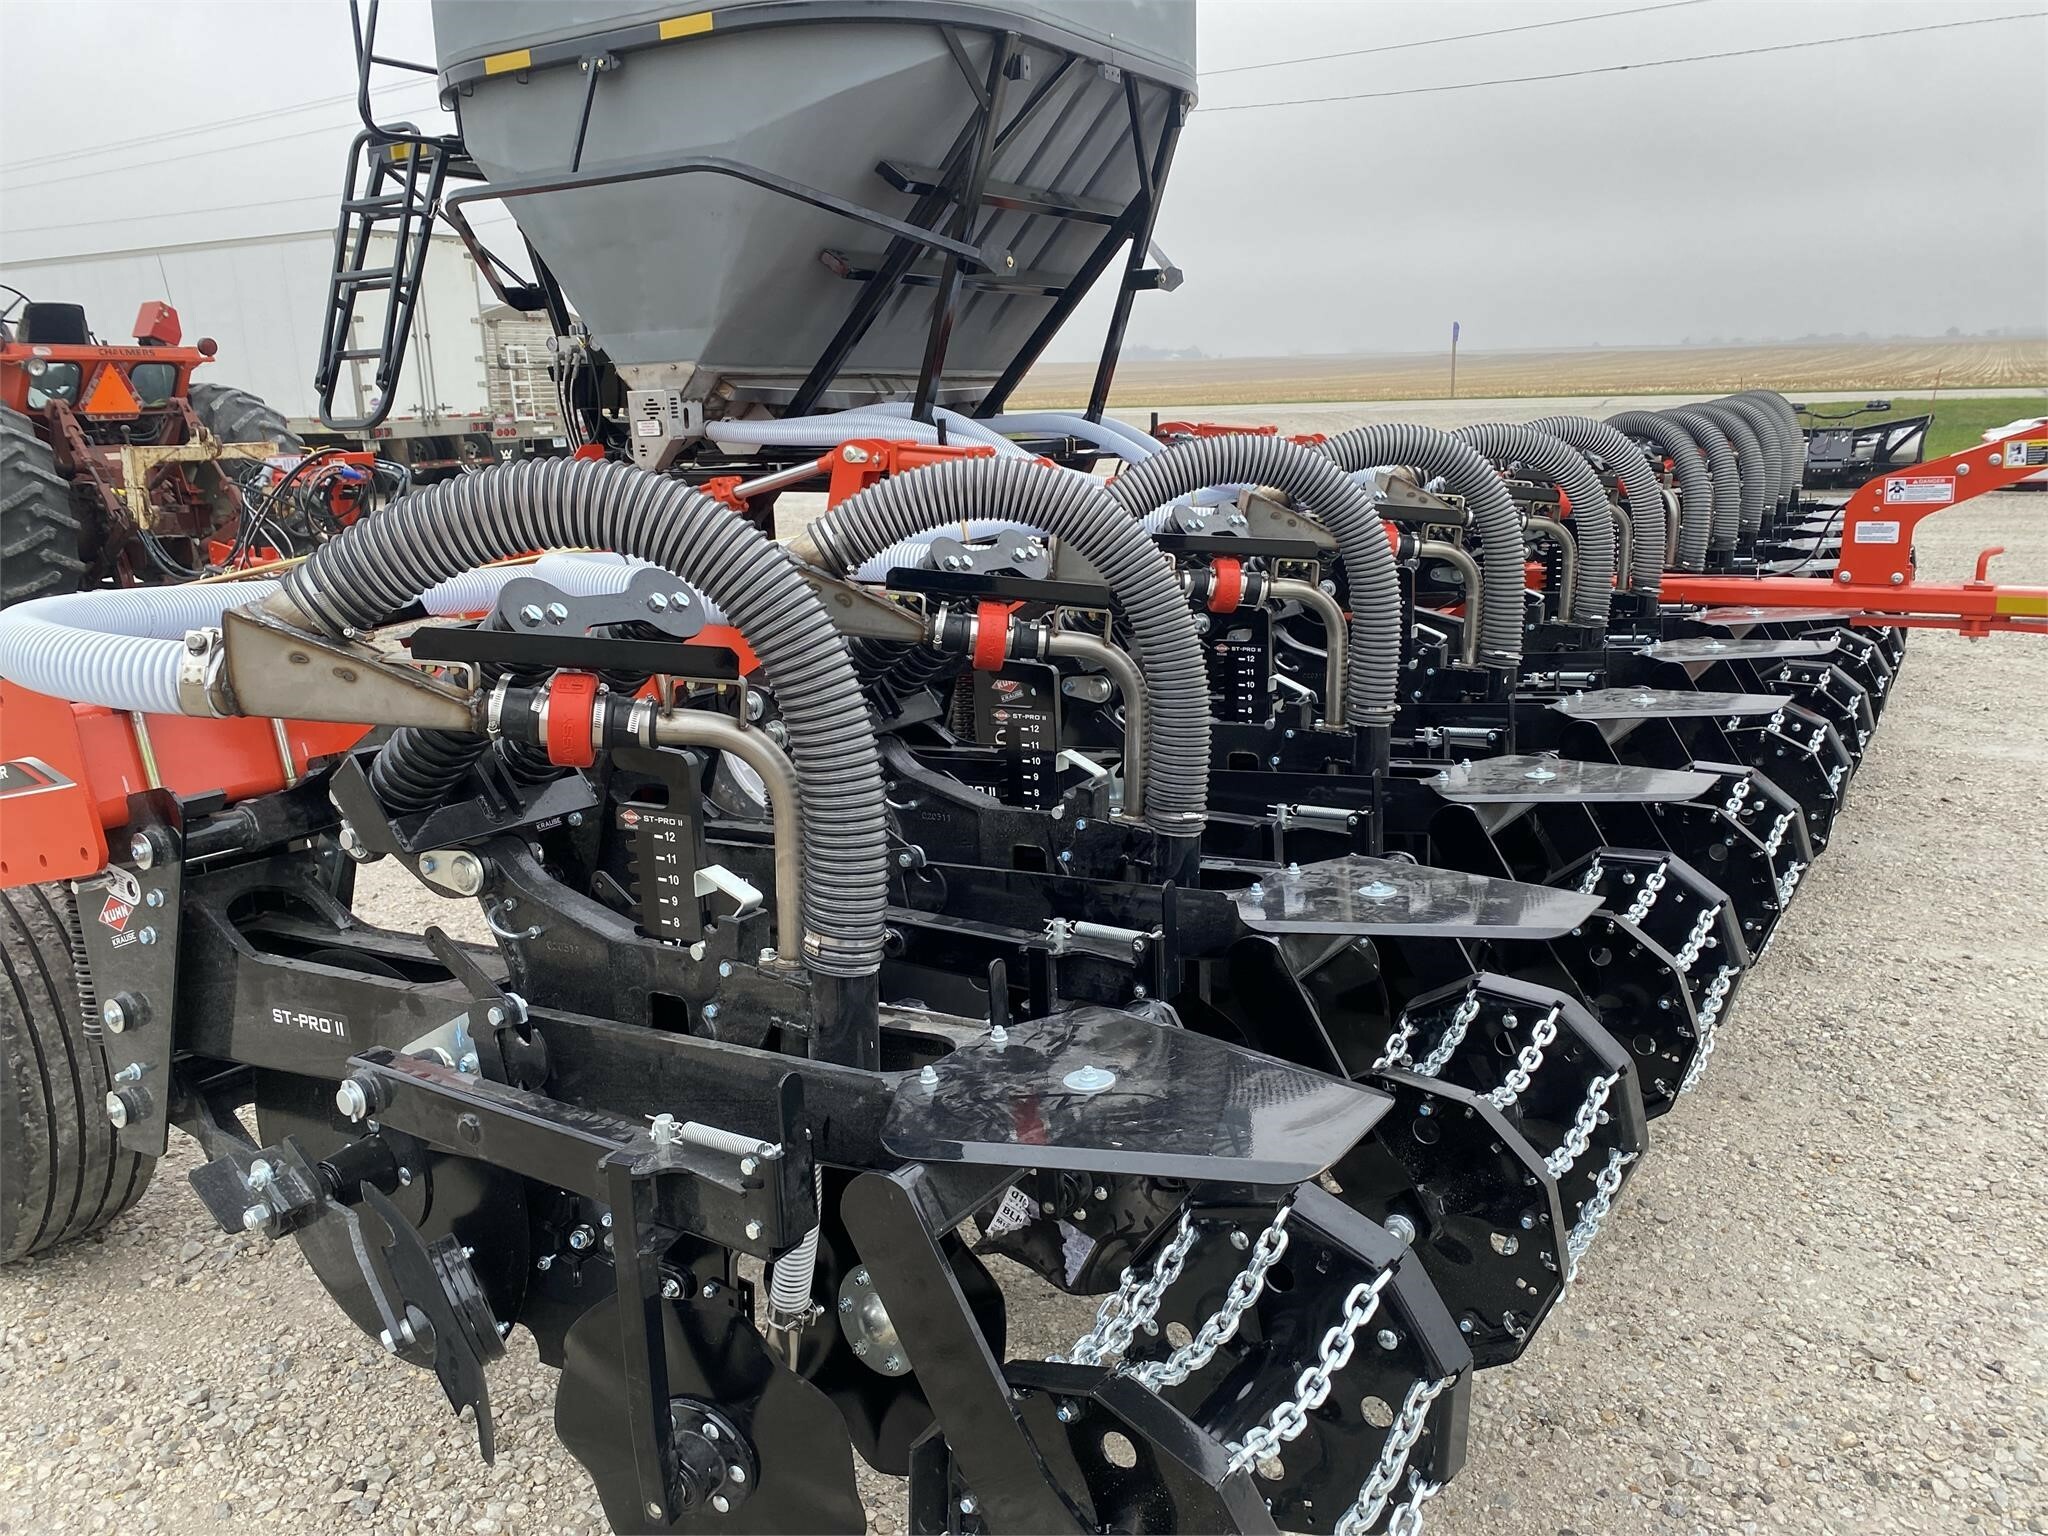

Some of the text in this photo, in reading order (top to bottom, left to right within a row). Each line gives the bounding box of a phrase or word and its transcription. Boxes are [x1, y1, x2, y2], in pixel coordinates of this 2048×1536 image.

[98, 348, 156, 357] CHALMERS
[1012, 713, 1041, 721] ST-PRO
[1029, 725, 1040, 733] 12
[1030, 741, 1040, 749] 11
[1031, 757, 1041, 765] 10
[1033, 773, 1039, 781] 9
[1034, 789, 1040, 797] 8
[536, 817, 563, 830] KRAUSE
[643, 815, 683, 827] ST-PRO II
[664, 831, 676, 843] 12
[666, 854, 677, 864] 11
[668, 875, 680, 886] 10
[671, 896, 678, 906] 9
[103, 904, 129, 924] KUHN
[673, 917, 680, 928] 8
[111, 931, 137, 947] KRAUSE
[675, 938, 682, 948] 7
[272, 1008, 345, 1037] ST-PRO II
